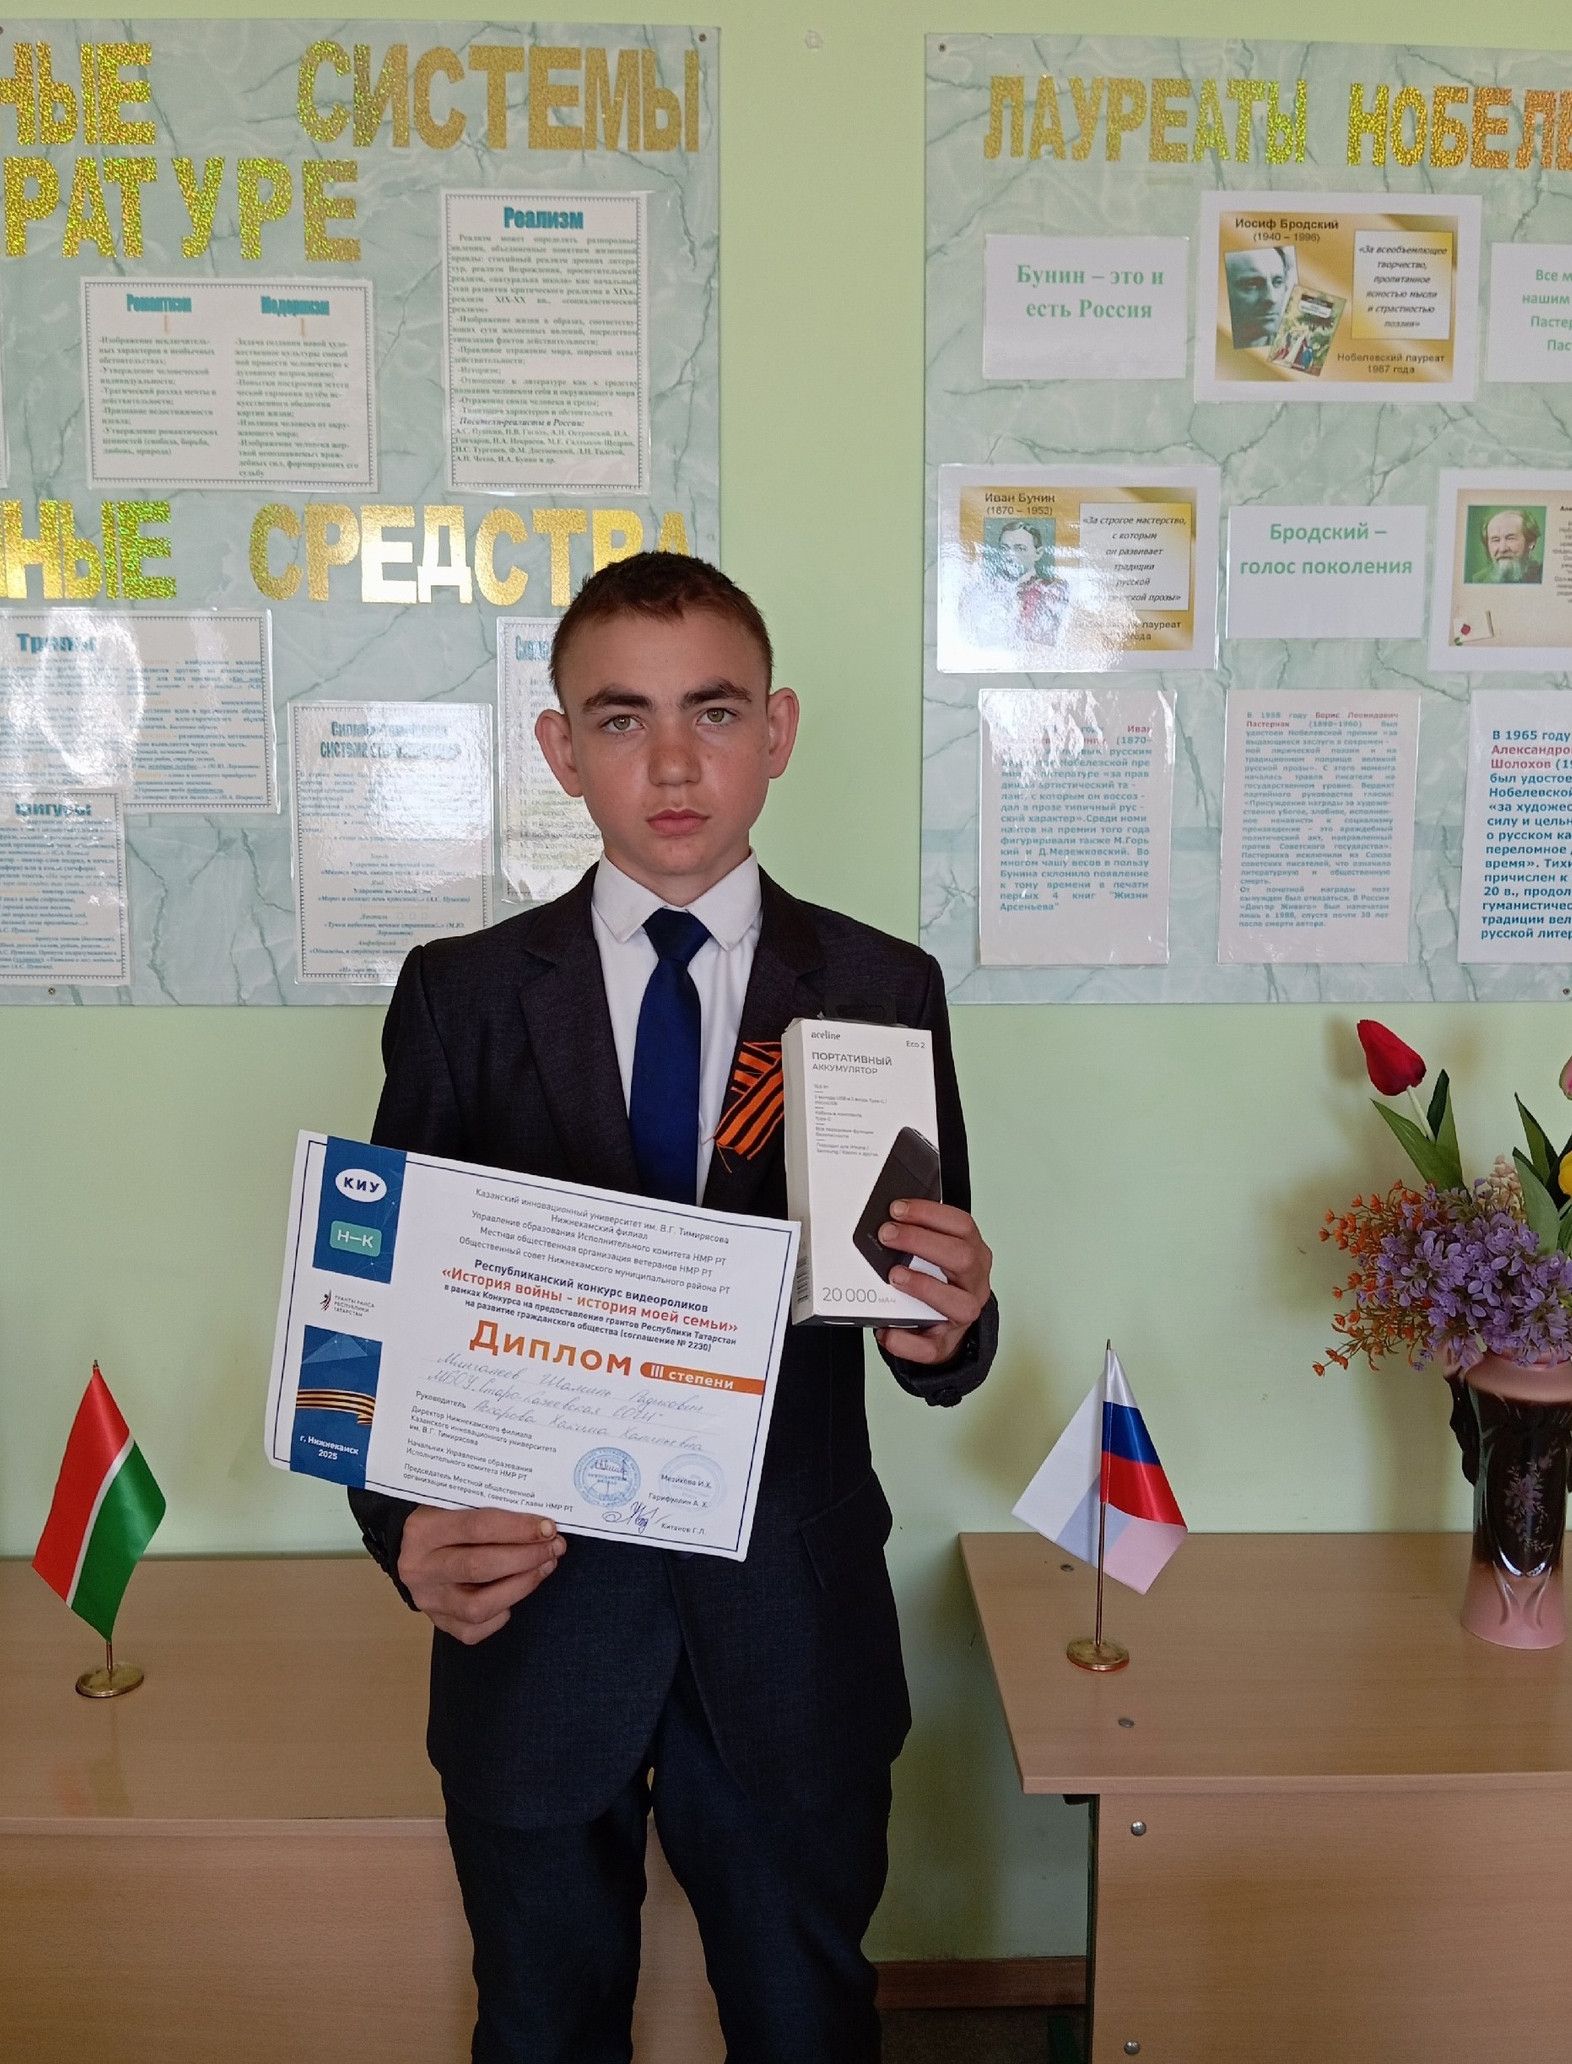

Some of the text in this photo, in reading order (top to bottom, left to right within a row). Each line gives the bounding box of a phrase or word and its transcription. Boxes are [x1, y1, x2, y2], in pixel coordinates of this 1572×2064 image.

[297, 39, 700, 152] СИСТЕМЫ
[983, 75, 1306, 164] ЛАУРЕАТЫ
[3, 156, 362, 262] РАТУРЕ
[503, 207, 584, 230] Реализм
[1235, 218, 1339, 232] Иосиф Бродский
[1253, 233, 1281, 243] (1940
[1017, 265, 1164, 288] Бунин это и
[1536, 269, 1558, 281] Все
[1522, 294, 1570, 304] нашим
[1026, 299, 1152, 318] есть Россия
[1405, 355, 1444, 363] лауреат
[985, 493, 1055, 504] Иван Бунин
[987, 506, 1014, 516] (1870
[1100, 517, 1133, 526] строгое
[1119, 532, 1157, 540] которым
[1270, 523, 1369, 543] Бродский
[0, 499, 177, 599] НЫЕ
[1119, 548, 1163, 556] развивает
[1240, 561, 1412, 574] голос поколения
[1492, 730, 1570, 743] В 1965 году
[1491, 745, 1572, 757] Александро
[1491, 759, 1551, 769] Шолохов
[1490, 774, 1572, 787] был удостое
[1489, 803, 1572, 814] «за художес
[1487, 817, 1518, 827] силу
[1487, 832, 1494, 840] о
[1499, 832, 1552, 842] русском
[1486, 846, 1567, 856] переломное
[1485, 860, 1539, 870] время».
[1484, 874, 1568, 884] причислен к
[1484, 886, 1499, 896] 20
[1524, 888, 1571, 898] продол
[1482, 902, 1572, 912] гуманистичес
[1481, 916, 1572, 926] традиции вел
[1481, 928, 1533, 940] русской
[811, 1030, 841, 1040] aceline
[812, 1052, 892, 1066] ПОРТАТИВНЫЙ
[812, 1064, 878, 1074] АККУМУЛЯТОР
[343, 1176, 379, 1192] КИУ
[615, 1227, 647, 1239] филиал
[474, 1259, 707, 1312] Республиканский конкурс видеороликов
[442, 1267, 737, 1331] «История войны история моей семьи»
[450, 1285, 736, 1344] рамках Конкурса предоставление грантов Республики Татарстан
[476, 1302, 514, 1315] развитие
[516, 1311, 575, 1327] гражданского
[576, 1322, 618, 1336] общества
[469, 1320, 733, 1392] Диплом степени
[307, 1436, 358, 1454] Нижнекамск
[318, 1448, 337, 1459] 2025
